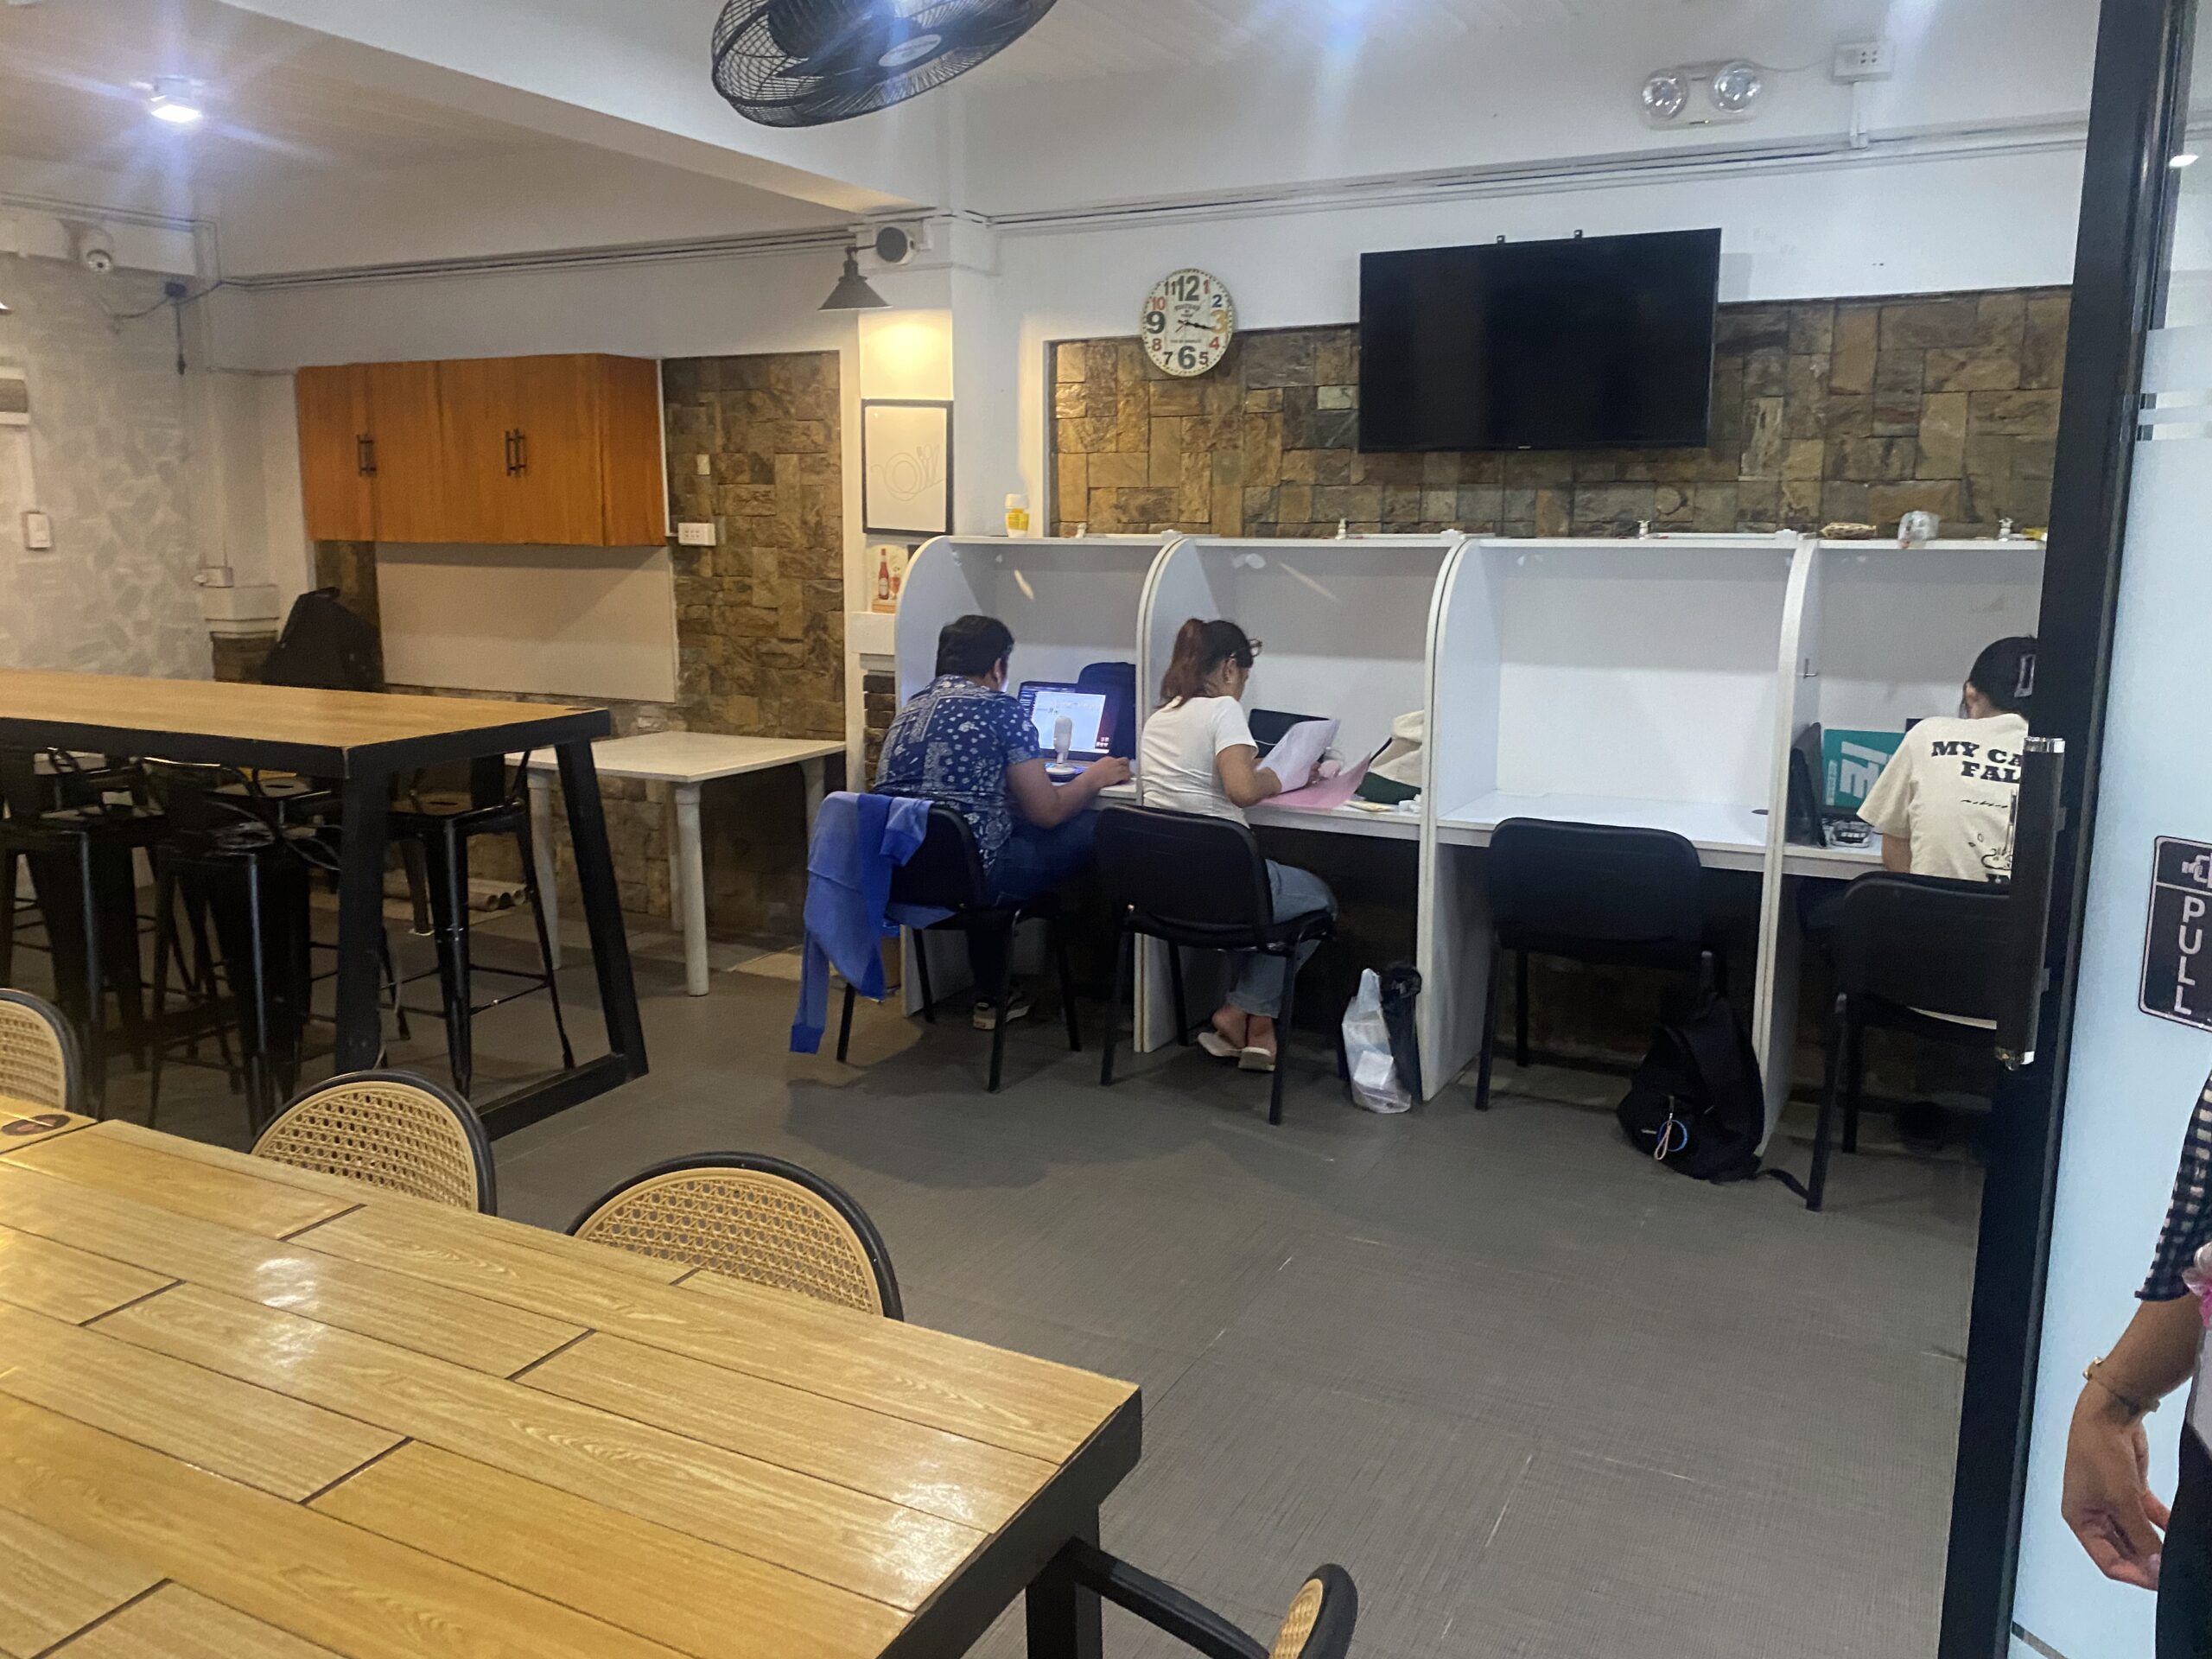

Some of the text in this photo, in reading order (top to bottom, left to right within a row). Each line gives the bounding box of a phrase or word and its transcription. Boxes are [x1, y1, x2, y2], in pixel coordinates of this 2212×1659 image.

[1164, 281, 1176, 296] 11
[1175, 276, 1200, 302] 12
[1203, 279, 1210, 295] 1
[1152, 296, 1166, 310] 10
[1211, 295, 1223, 308] 2
[1147, 311, 1166, 334] 9
[1210, 309, 1227, 334] 3
[1152, 338, 1162, 352] 8
[1209, 337, 1220, 350] 4
[1163, 351, 1173, 365] 7
[1178, 346, 1196, 370] 6
[1198, 352, 1209, 365] 5
[1931, 741, 1980, 757] MY
[2174, 895, 2206, 1015] PULL
